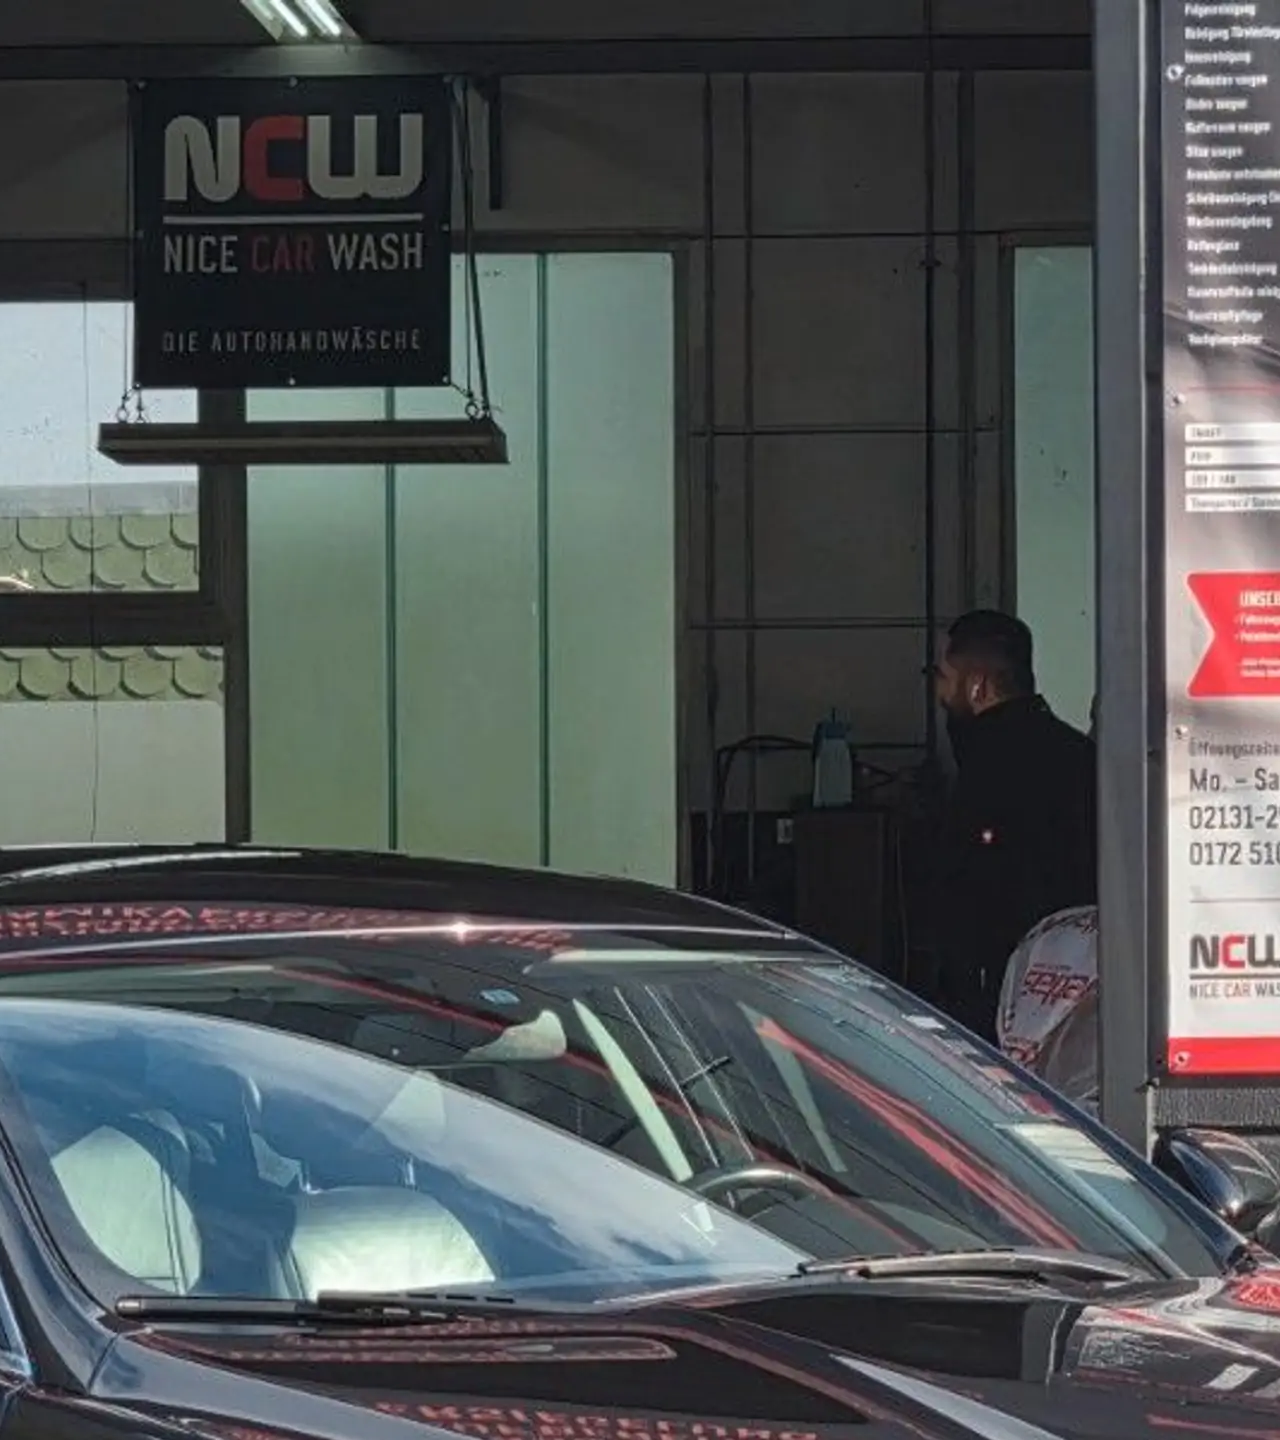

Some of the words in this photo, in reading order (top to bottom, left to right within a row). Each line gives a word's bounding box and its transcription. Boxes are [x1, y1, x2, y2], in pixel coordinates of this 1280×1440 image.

[163, 114, 424, 201] NCW
[163, 234, 238, 273] NICE
[251, 233, 315, 272] CAR
[328, 232, 424, 270] WASH
[162, 330, 200, 353] DIE
[211, 326, 421, 352] AUTOHANDWÄSCHE
[1189, 768, 1228, 792] Mo.
[1189, 842, 1241, 866] 0172
[1189, 983, 1220, 999] NICE
[1224, 982, 1252, 998] CAR
